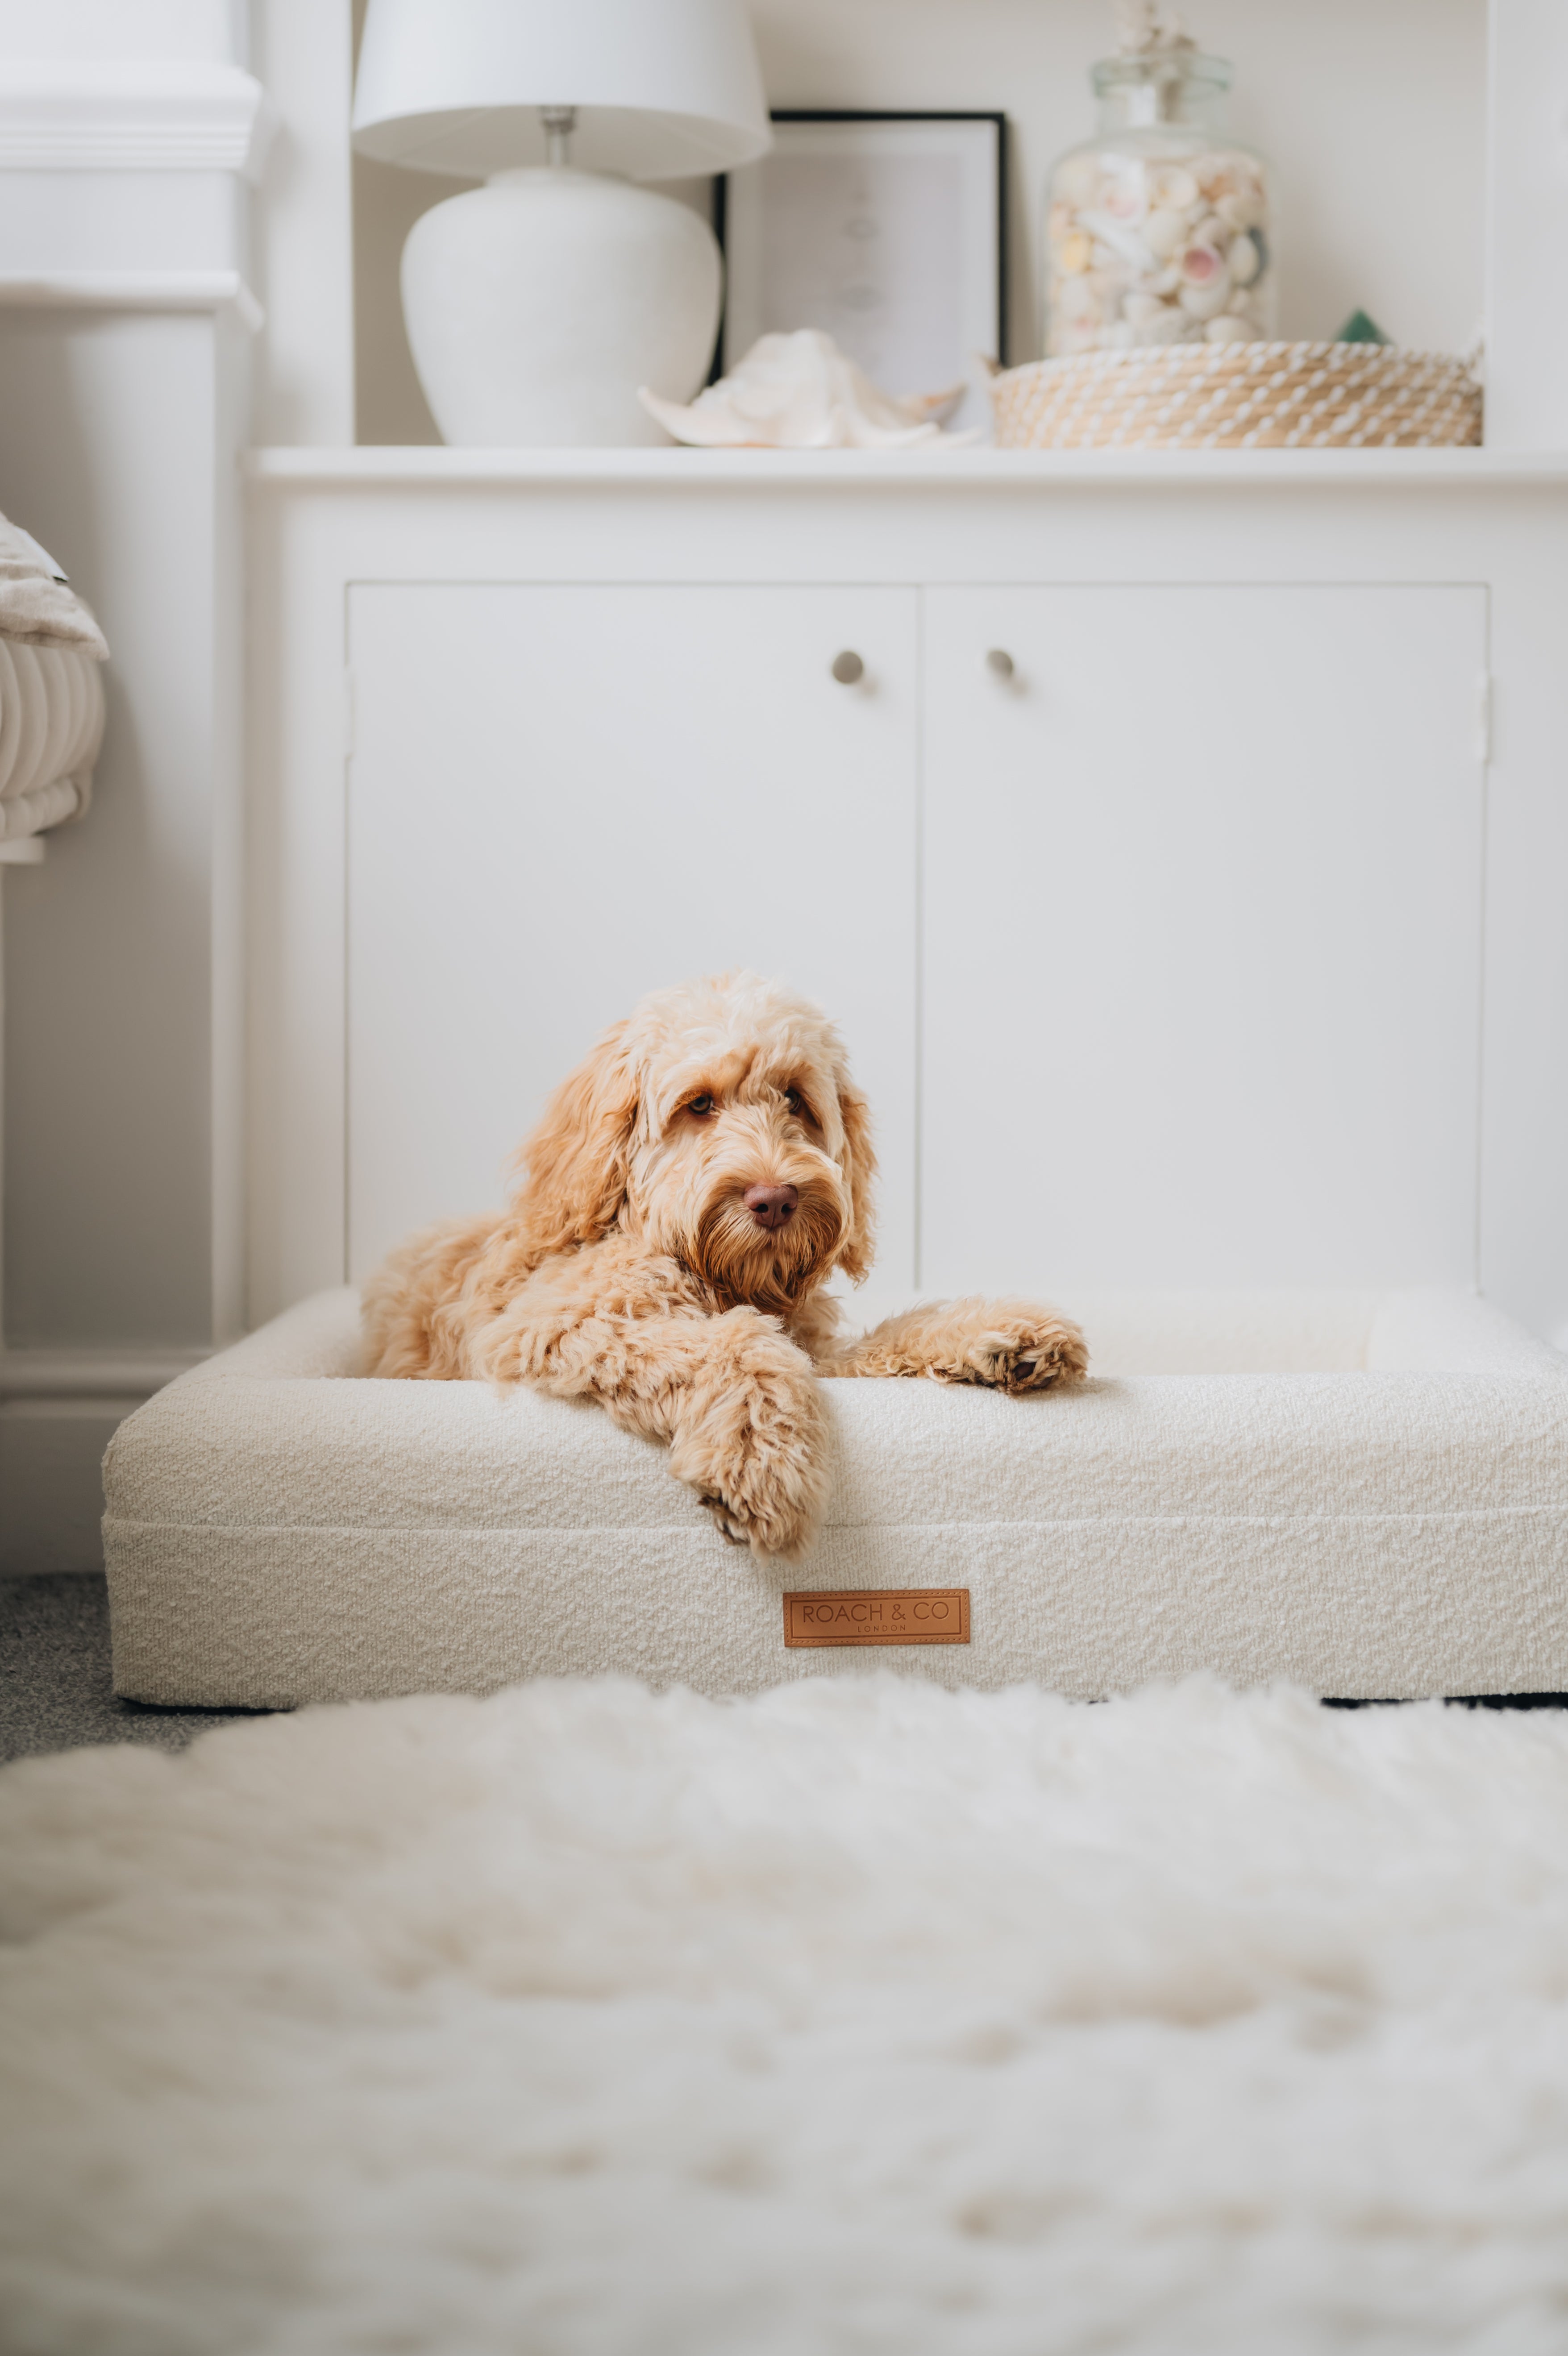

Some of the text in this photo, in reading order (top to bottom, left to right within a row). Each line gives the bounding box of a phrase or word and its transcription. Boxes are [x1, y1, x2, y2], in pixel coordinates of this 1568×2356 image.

[803, 1601, 949, 1623] ROACH & CO
[858, 1625, 906, 1633] LONDON
